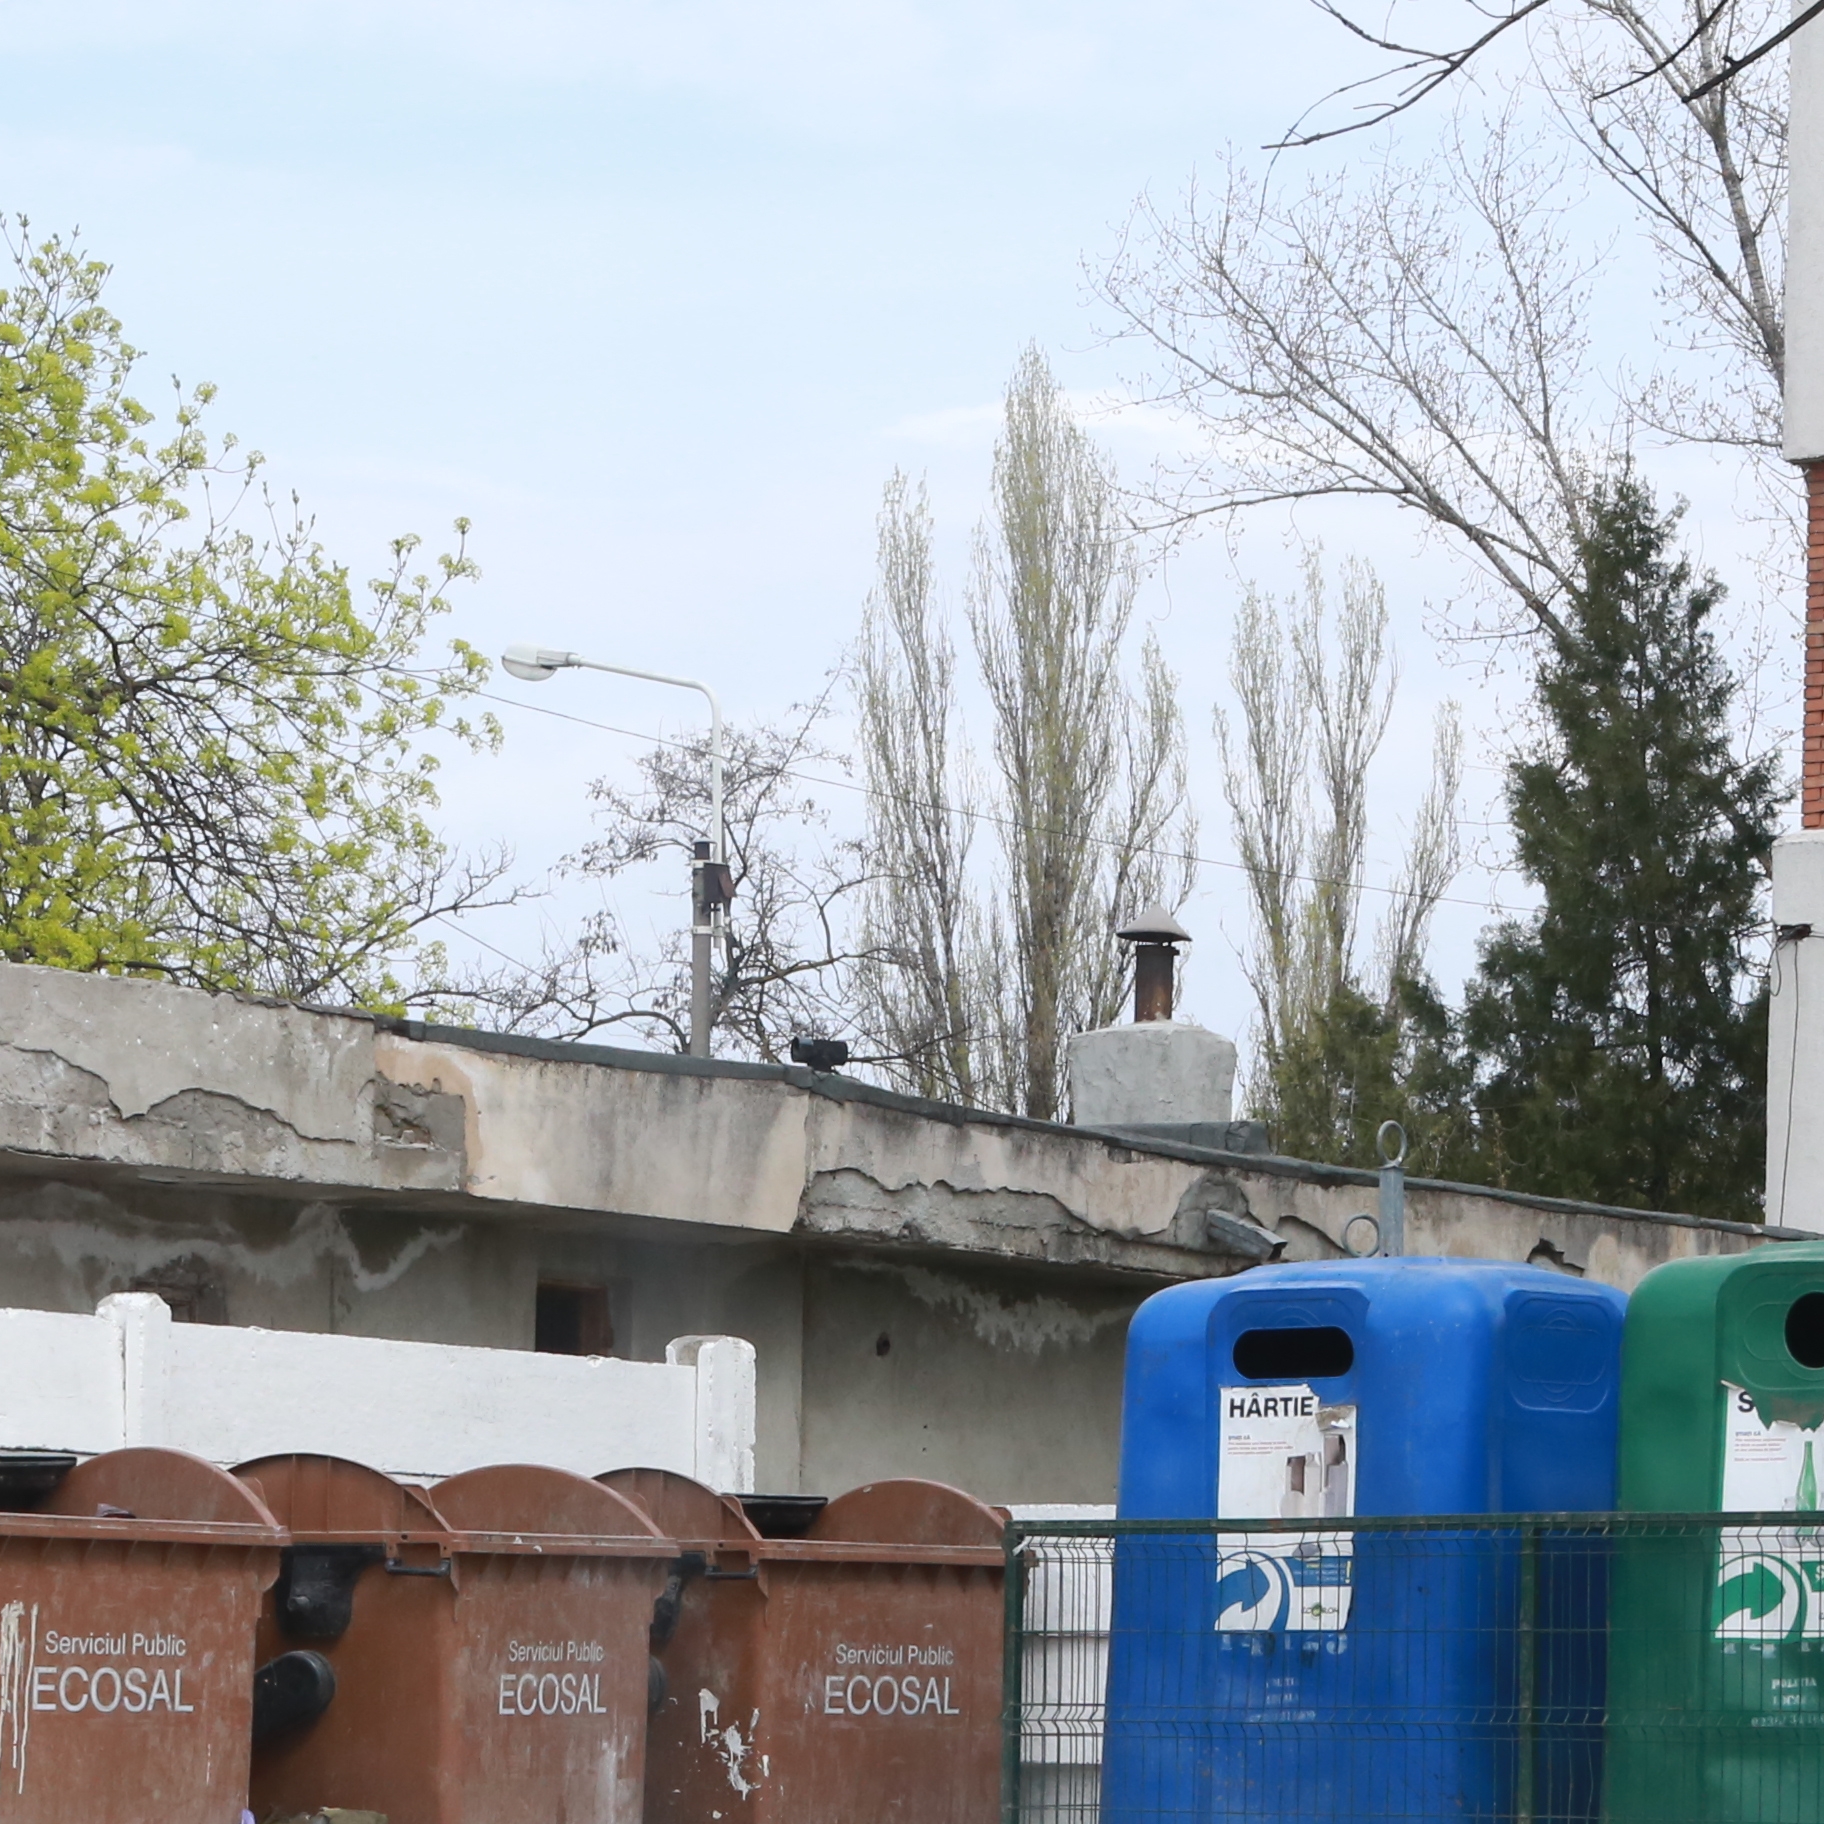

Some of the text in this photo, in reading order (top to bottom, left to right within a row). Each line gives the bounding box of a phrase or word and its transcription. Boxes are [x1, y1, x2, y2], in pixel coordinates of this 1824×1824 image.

[1229, 1392, 1314, 1418] HÂRTIE
[45, 1630, 187, 1657] Serviciul Public
[509, 1640, 604, 1663] Serviciul Public
[835, 1643, 954, 1666] Serviciul Public
[32, 1666, 194, 1713] ECOSAL
[499, 1673, 607, 1715] ECOSAL
[824, 1675, 960, 1715] ECOSAL
